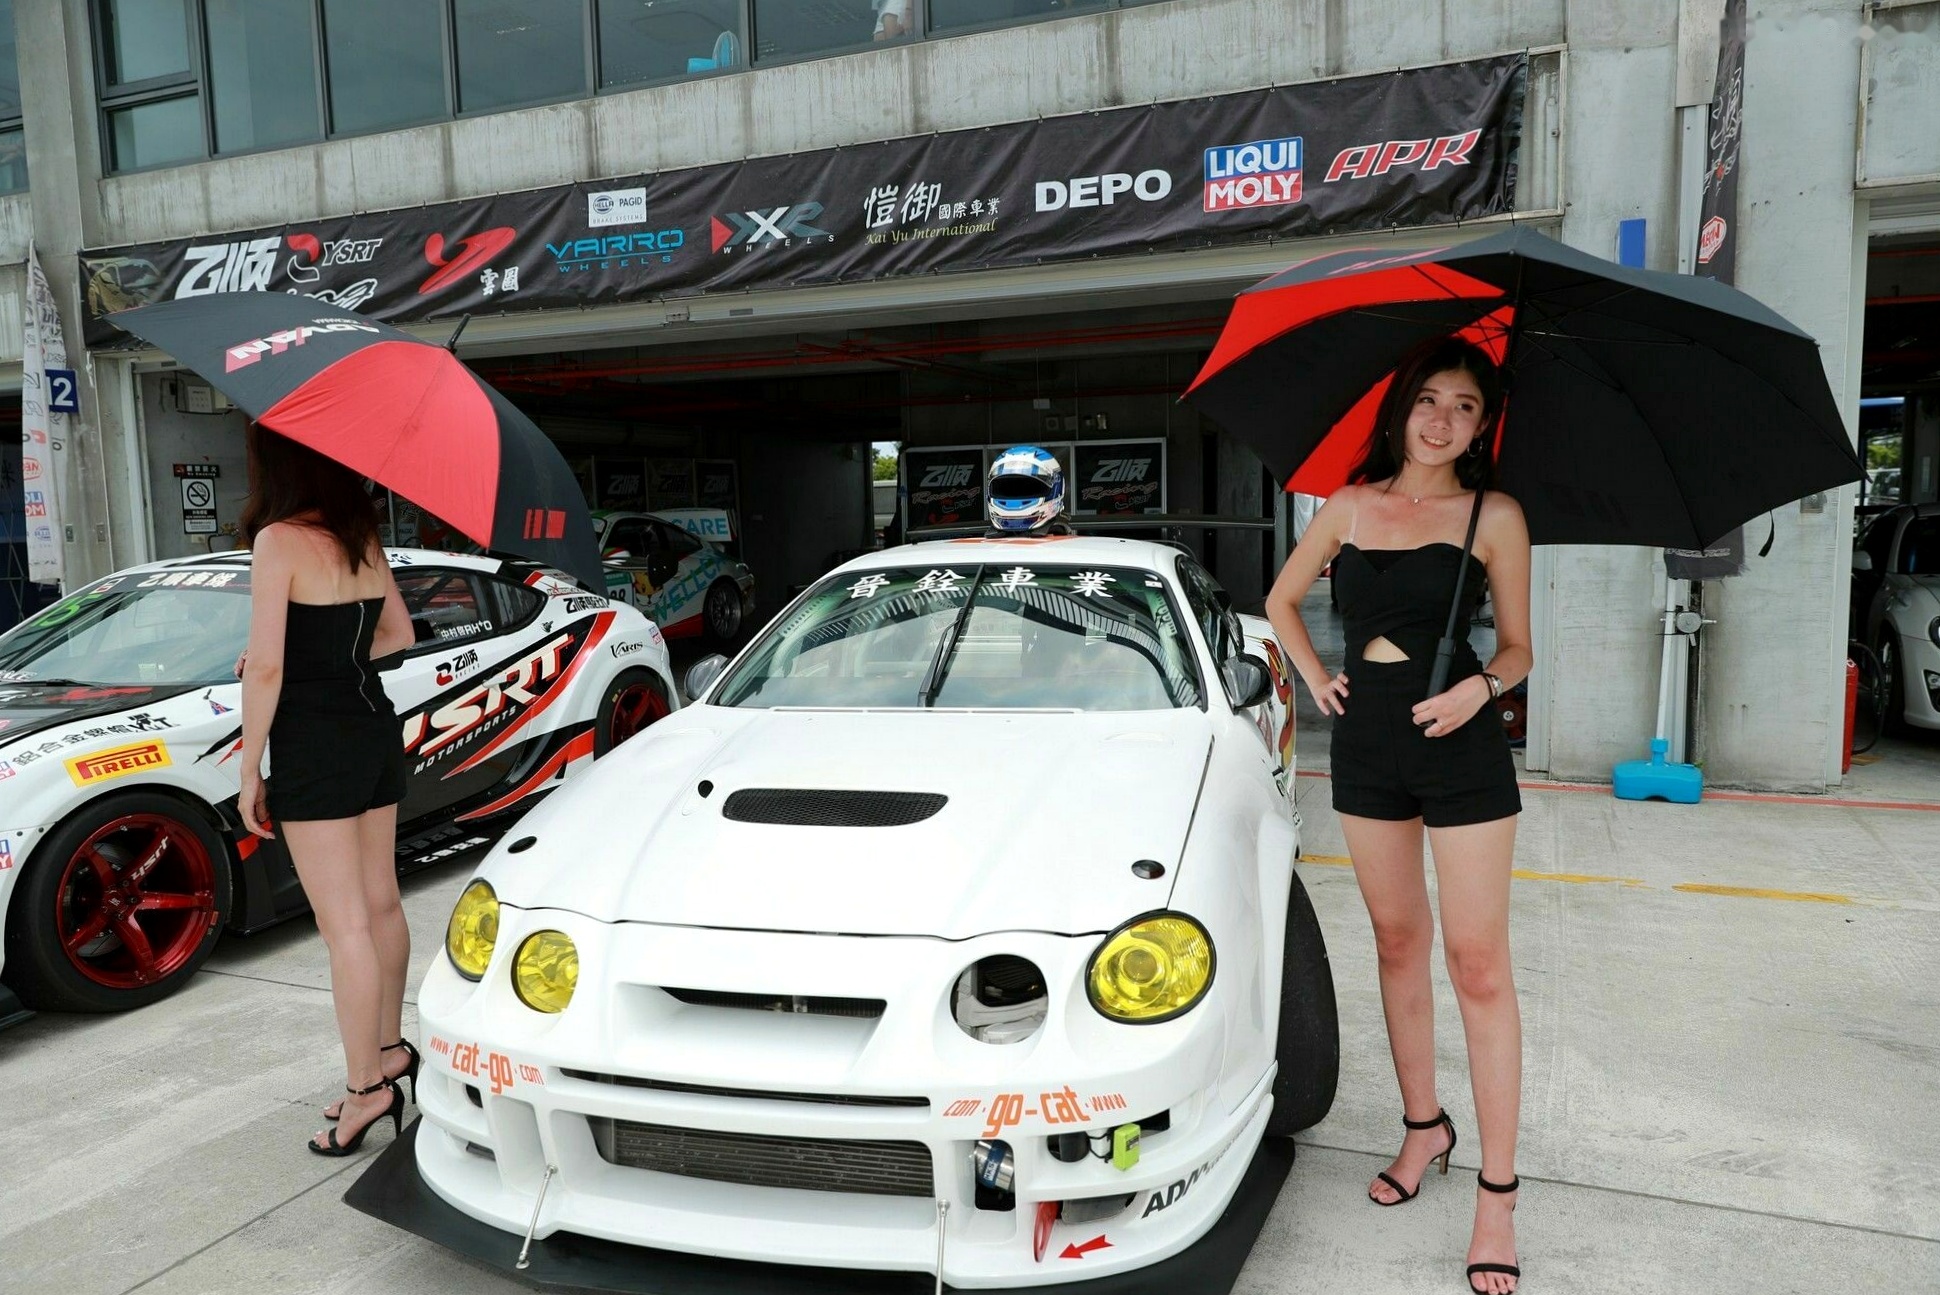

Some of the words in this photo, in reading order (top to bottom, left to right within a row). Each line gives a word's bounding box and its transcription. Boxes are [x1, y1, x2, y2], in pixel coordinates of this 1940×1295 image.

[1210, 140, 1298, 179] LIQUI
[1323, 128, 1483, 183] APR
[619, 196, 643, 207] PAGID
[1035, 169, 1172, 212] DEPO
[1207, 173, 1299, 209] MOLY
[615, 214, 643, 222] SYSTEMS
[865, 231, 886, 246] Kai
[891, 230, 908, 246] Yu
[911, 216, 998, 240] International
[321, 238, 383, 266] YSRT
[545, 229, 684, 259] VARRO
[723, 234, 835, 254] WHEELS
[559, 255, 671, 273] WHEELS
[413, 704, 517, 776] MOTORSPORTS
[75, 744, 163, 780] PIRELLI
